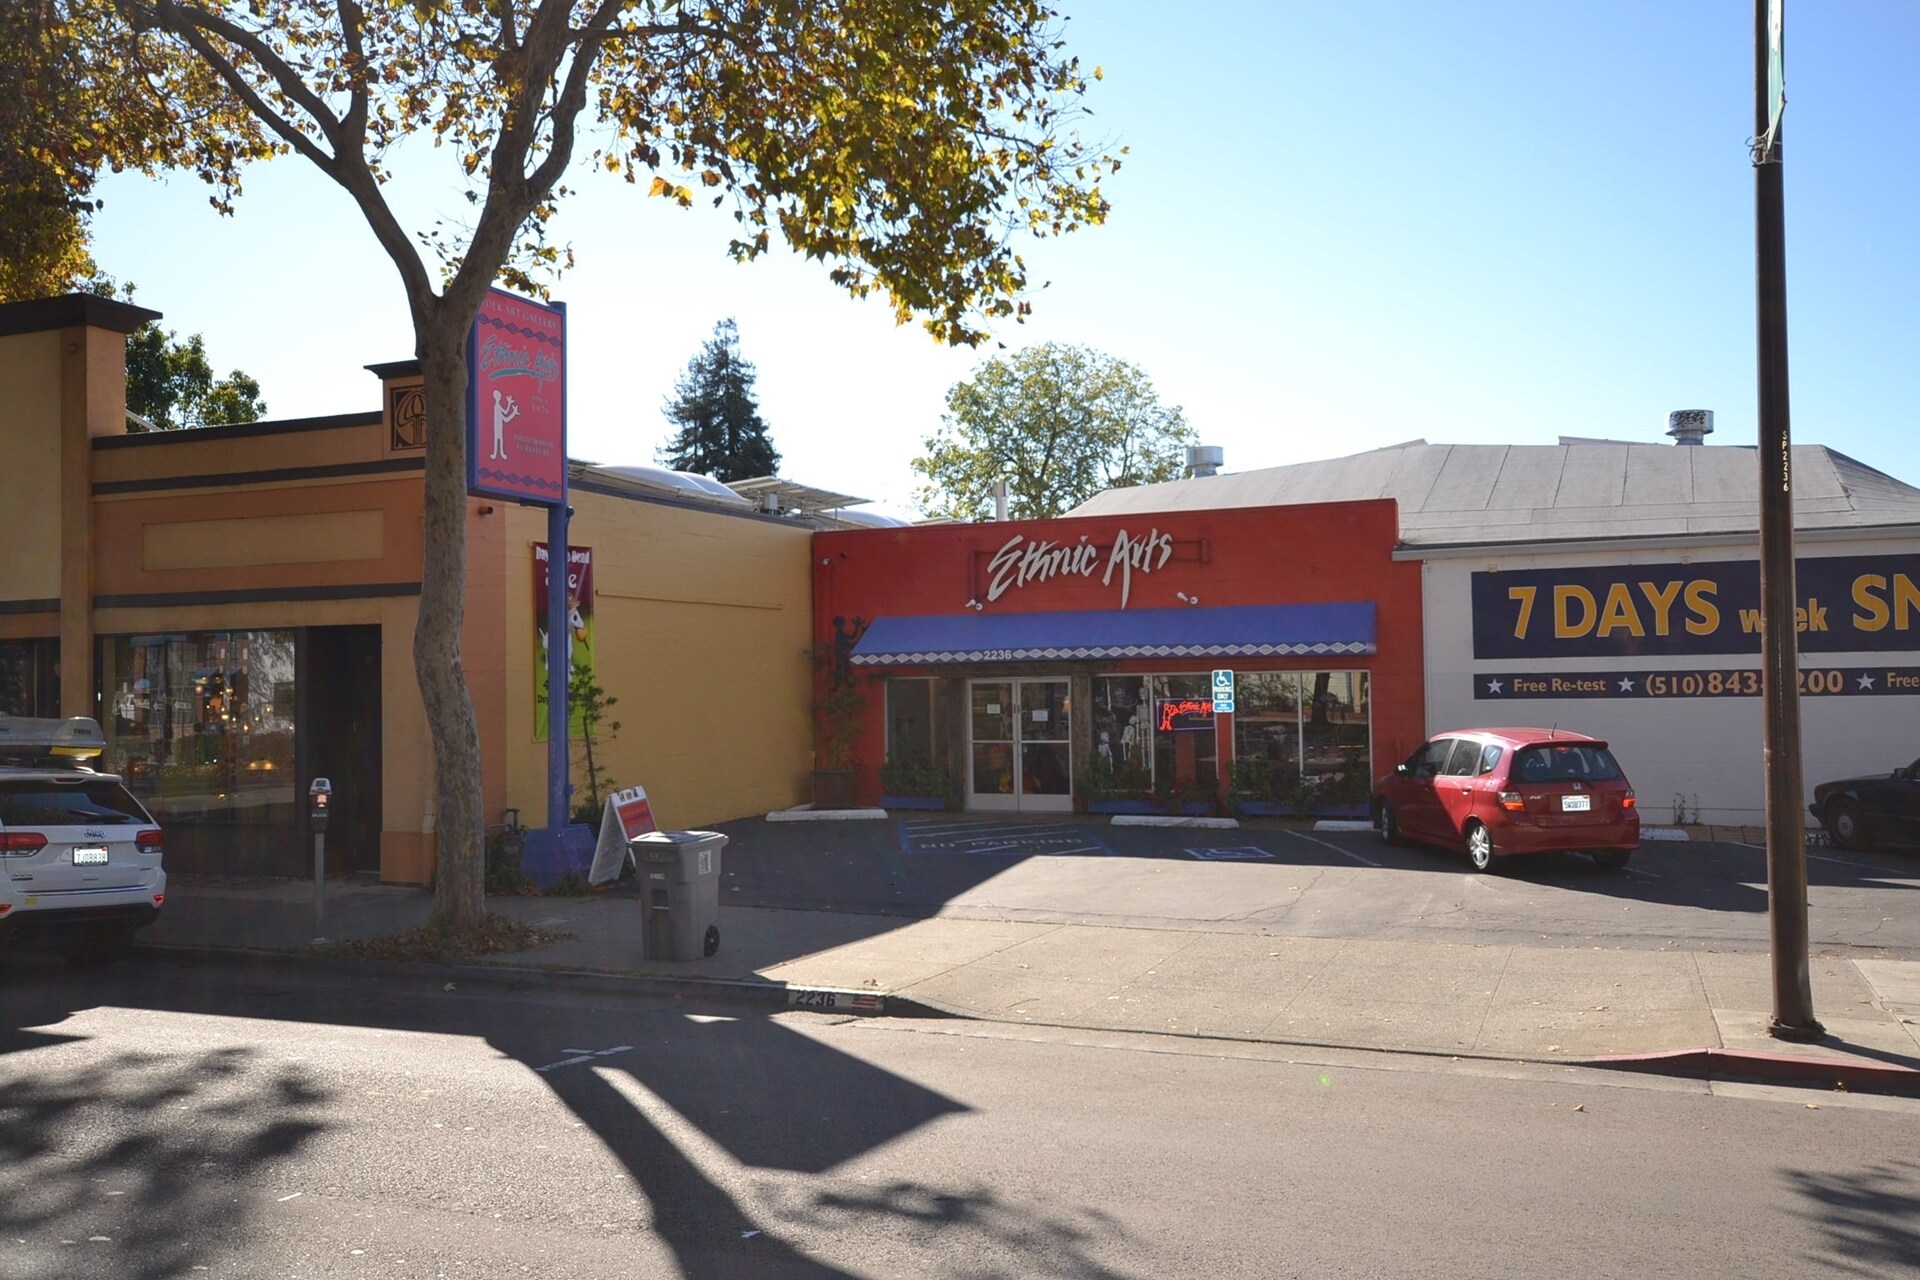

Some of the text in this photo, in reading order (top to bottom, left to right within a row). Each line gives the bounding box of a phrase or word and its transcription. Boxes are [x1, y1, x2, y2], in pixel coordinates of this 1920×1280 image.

[504, 306, 520, 318] ART
[522, 311, 558, 329] GALLERY
[571, 550, 590, 564] Dead
[987, 528, 1172, 610] Ethnic Arts
[1508, 586, 1537, 640] 7
[1553, 579, 1721, 638] DAYS
[1738, 598, 1829, 633] wek
[983, 650, 1012, 661] 2236
[1513, 678, 1548, 692] Free
[1551, 677, 1606, 692] Re-test
[1887, 672, 1920, 688] Free
[970, 838, 1083, 847] PARKING
[796, 989, 835, 1007] 2236
